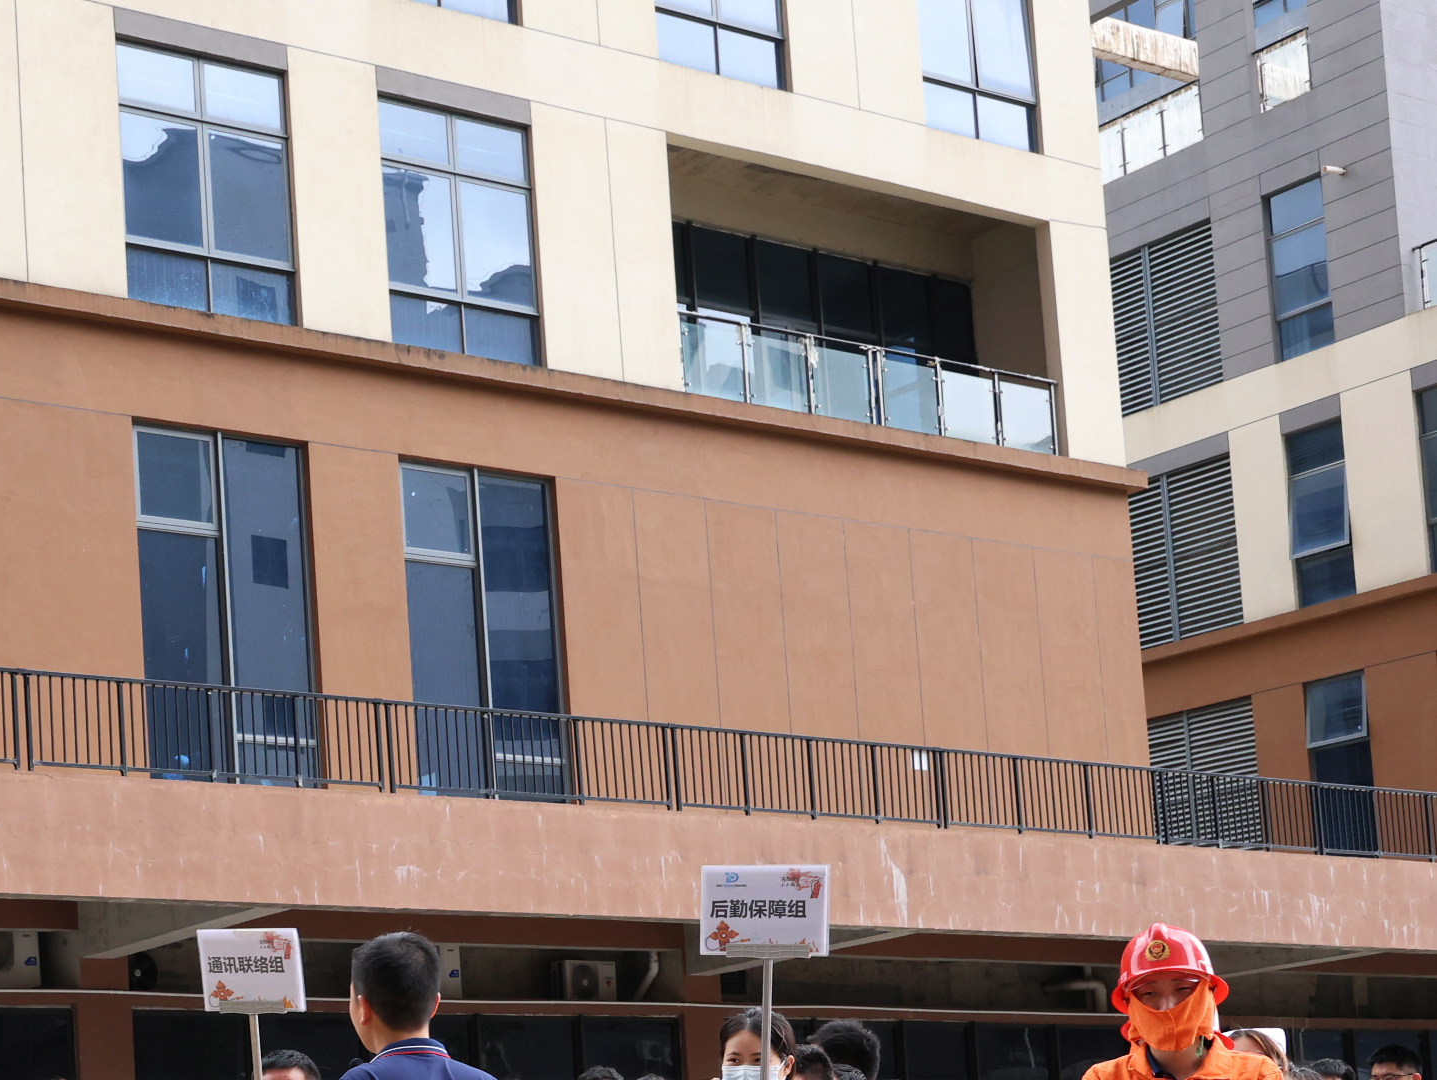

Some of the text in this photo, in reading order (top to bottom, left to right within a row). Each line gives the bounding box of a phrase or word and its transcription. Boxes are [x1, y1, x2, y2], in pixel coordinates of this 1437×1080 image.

[710, 899, 807, 919] 后勤保障组
[208, 956, 285, 974] 通讯联络组
